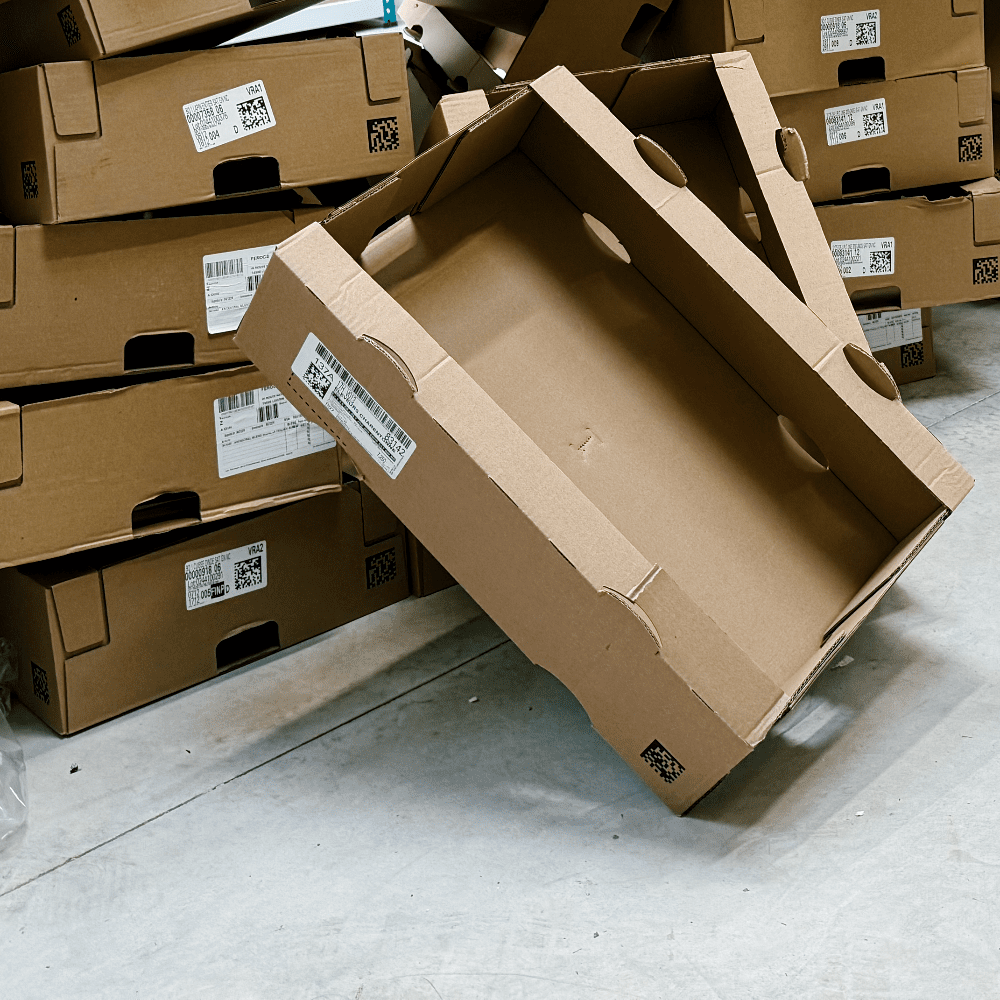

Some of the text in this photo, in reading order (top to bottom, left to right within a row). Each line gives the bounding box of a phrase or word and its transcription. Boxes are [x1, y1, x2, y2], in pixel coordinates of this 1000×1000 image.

[246, 84, 263, 95] VRA1
[209, 130, 220, 140] 004
[233, 125, 239, 134] D
[315, 357, 334, 382] 137A
[384, 433, 406, 457] 83142
[248, 543, 264, 555] VRA2
[201, 589, 211, 599] 005
[225, 585, 231, 594] D
